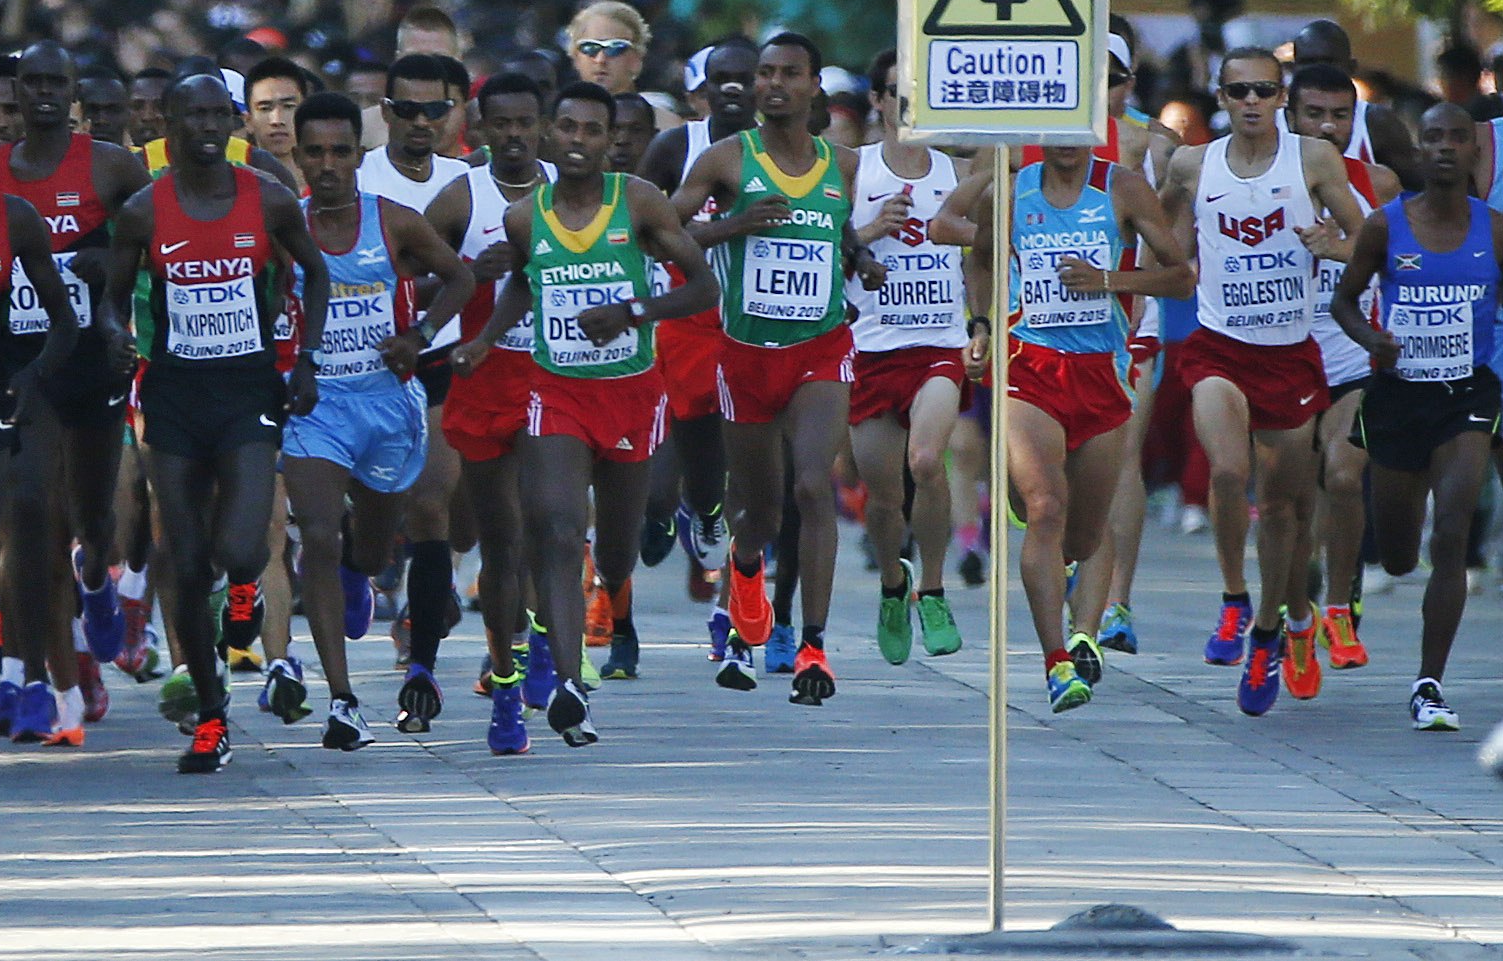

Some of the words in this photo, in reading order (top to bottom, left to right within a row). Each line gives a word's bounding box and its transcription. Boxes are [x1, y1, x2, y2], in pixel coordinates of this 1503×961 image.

[946, 46, 1045, 75] Caution
[941, 80, 1066, 104] 注意障碍物
[1217, 206, 1286, 248] USA
[1020, 229, 1110, 250] MONGOLIA
[770, 241, 826, 263] TDK
[897, 252, 951, 271] TDK
[1239, 250, 1297, 271] TDK
[165, 256, 254, 279] KENYA
[541, 261, 626, 285] ETHIOPIA
[188, 281, 247, 304] TDK
[755, 268, 818, 297] LEMI
[878, 280, 954, 306] BURRELL
[1221, 276, 1305, 308] EGGLESTON
[566, 286, 629, 306] TDK
[328, 296, 384, 319] TDK
[747, 301, 796, 317] BEIJING
[797, 306, 825, 318] 2015
[880, 312, 929, 325] BEIJING
[1029, 311, 1076, 325] BEIJING
[1078, 308, 1107, 323] 2015
[1226, 312, 1275, 327] BEIJING
[1276, 308, 1304, 324] 2015
[1409, 306, 1465, 326] TDK
[186, 306, 255, 338] KIPROTICH
[173, 342, 224, 357] BEIJING
[226, 338, 256, 354] 2015
[603, 346, 633, 361] 2015
[1398, 331, 1470, 359] HORIMBERE
